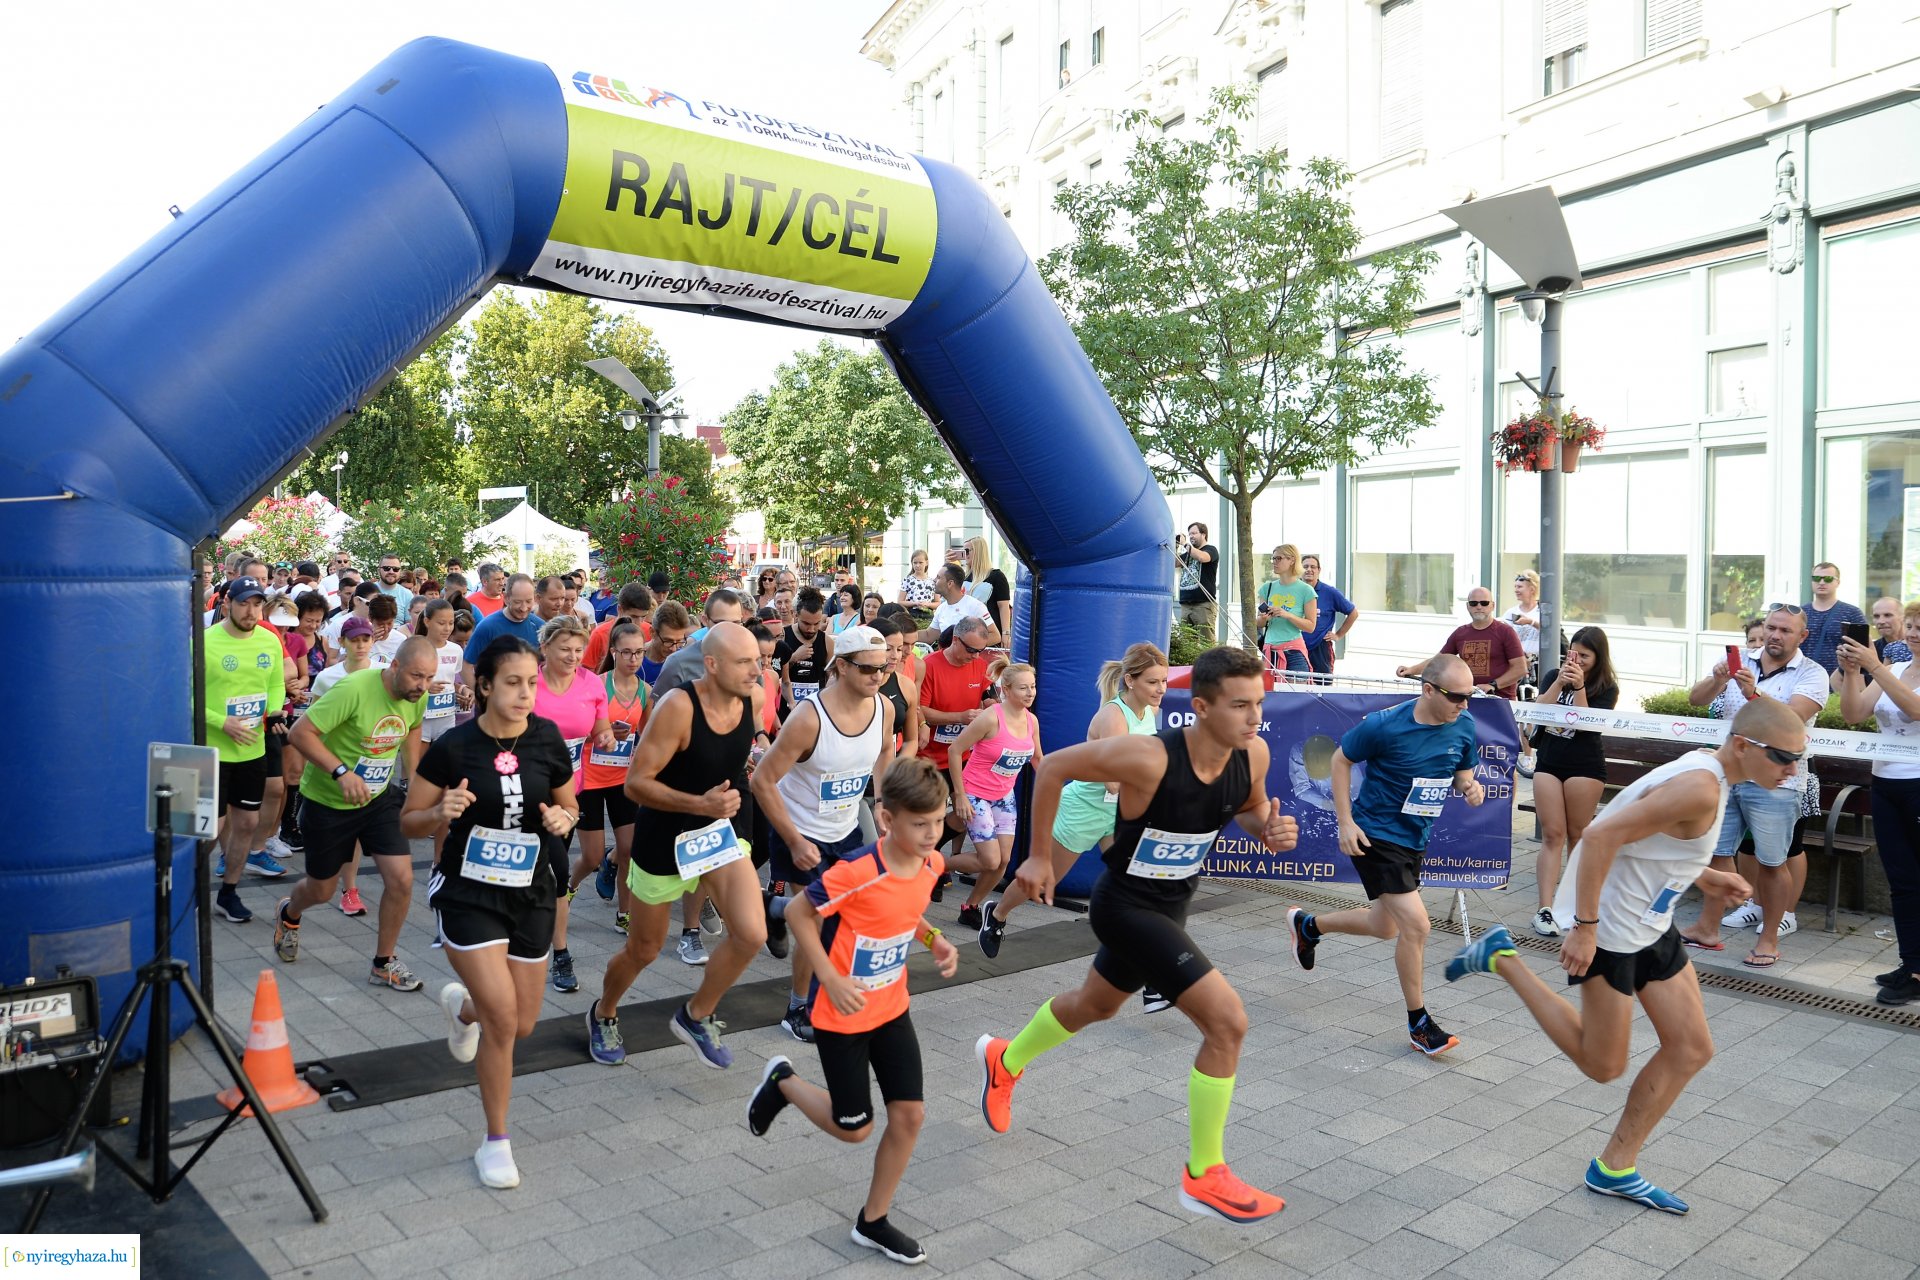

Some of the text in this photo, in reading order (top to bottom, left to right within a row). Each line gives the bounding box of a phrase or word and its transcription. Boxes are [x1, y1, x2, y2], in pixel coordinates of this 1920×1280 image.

[712, 116, 729, 127] az
[822, 142, 911, 171] támogatásával
[605, 148, 900, 265] RAJT/CÉL
[554, 256, 888, 321] www.nyiregyhazifutofesztival.hu
[235, 701, 260, 716] 524
[433, 694, 453, 706] 648
[1687, 726, 1718, 735] MOZAIK
[1810, 738, 1847, 747] MOZAIK
[1006, 756, 1027, 767] 653
[363, 766, 390, 779] 504
[831, 777, 863, 795] 560
[1419, 787, 1449, 801] 596
[500, 773, 524, 832] NIK
[201, 815, 209, 831] 7
[685, 831, 723, 856] 629
[1152, 843, 1200, 860] 624
[1215, 835, 1277, 857] ŐZÜNK,
[480, 841, 527, 864] 590
[1255, 860, 1267, 874] A
[1271, 861, 1335, 877] HELYED
[1420, 856, 1508, 869] vek.hu/karrier
[1419, 870, 1507, 884] rhamuvek.com
[868, 942, 910, 970] 581
